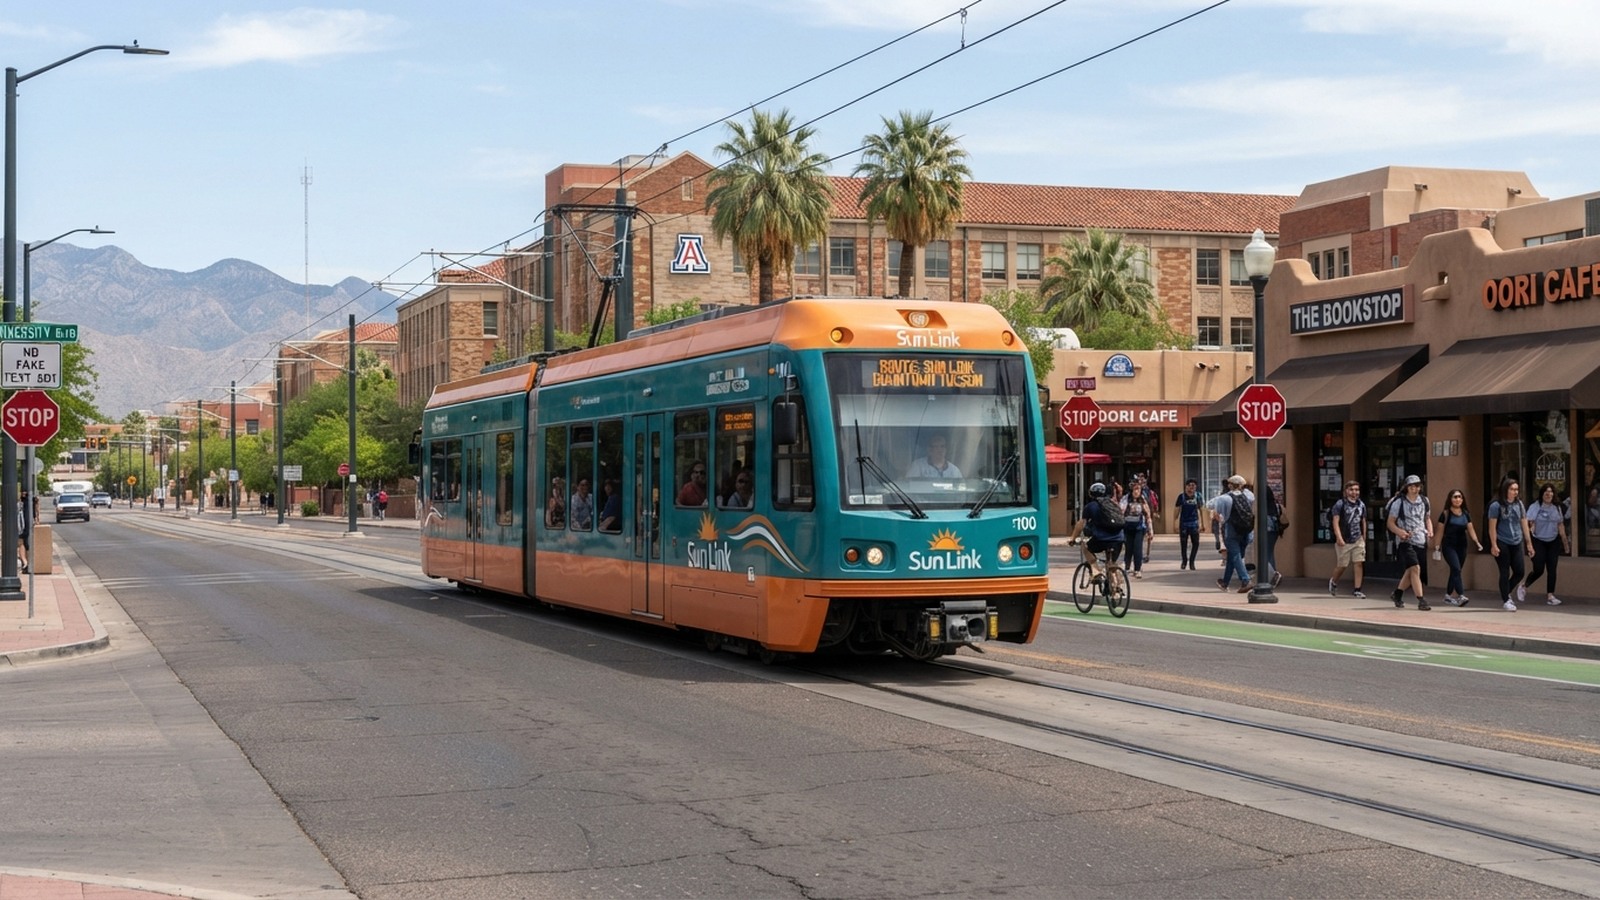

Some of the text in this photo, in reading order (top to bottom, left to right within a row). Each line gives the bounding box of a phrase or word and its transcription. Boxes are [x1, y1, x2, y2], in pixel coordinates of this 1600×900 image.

[670, 234, 710, 273] A
[1544, 263, 1600, 302] CAFE
[1292, 293, 1401, 330] THE BOOKSTOP
[929, 330, 961, 347] Link
[16, 360, 45, 370] FAKE
[6, 408, 55, 427] STOP
[1063, 410, 1098, 426] STOP
[1139, 410, 1178, 422] CAFE
[1241, 401, 1282, 421] STOP
[908, 548, 982, 570] Sun Link
